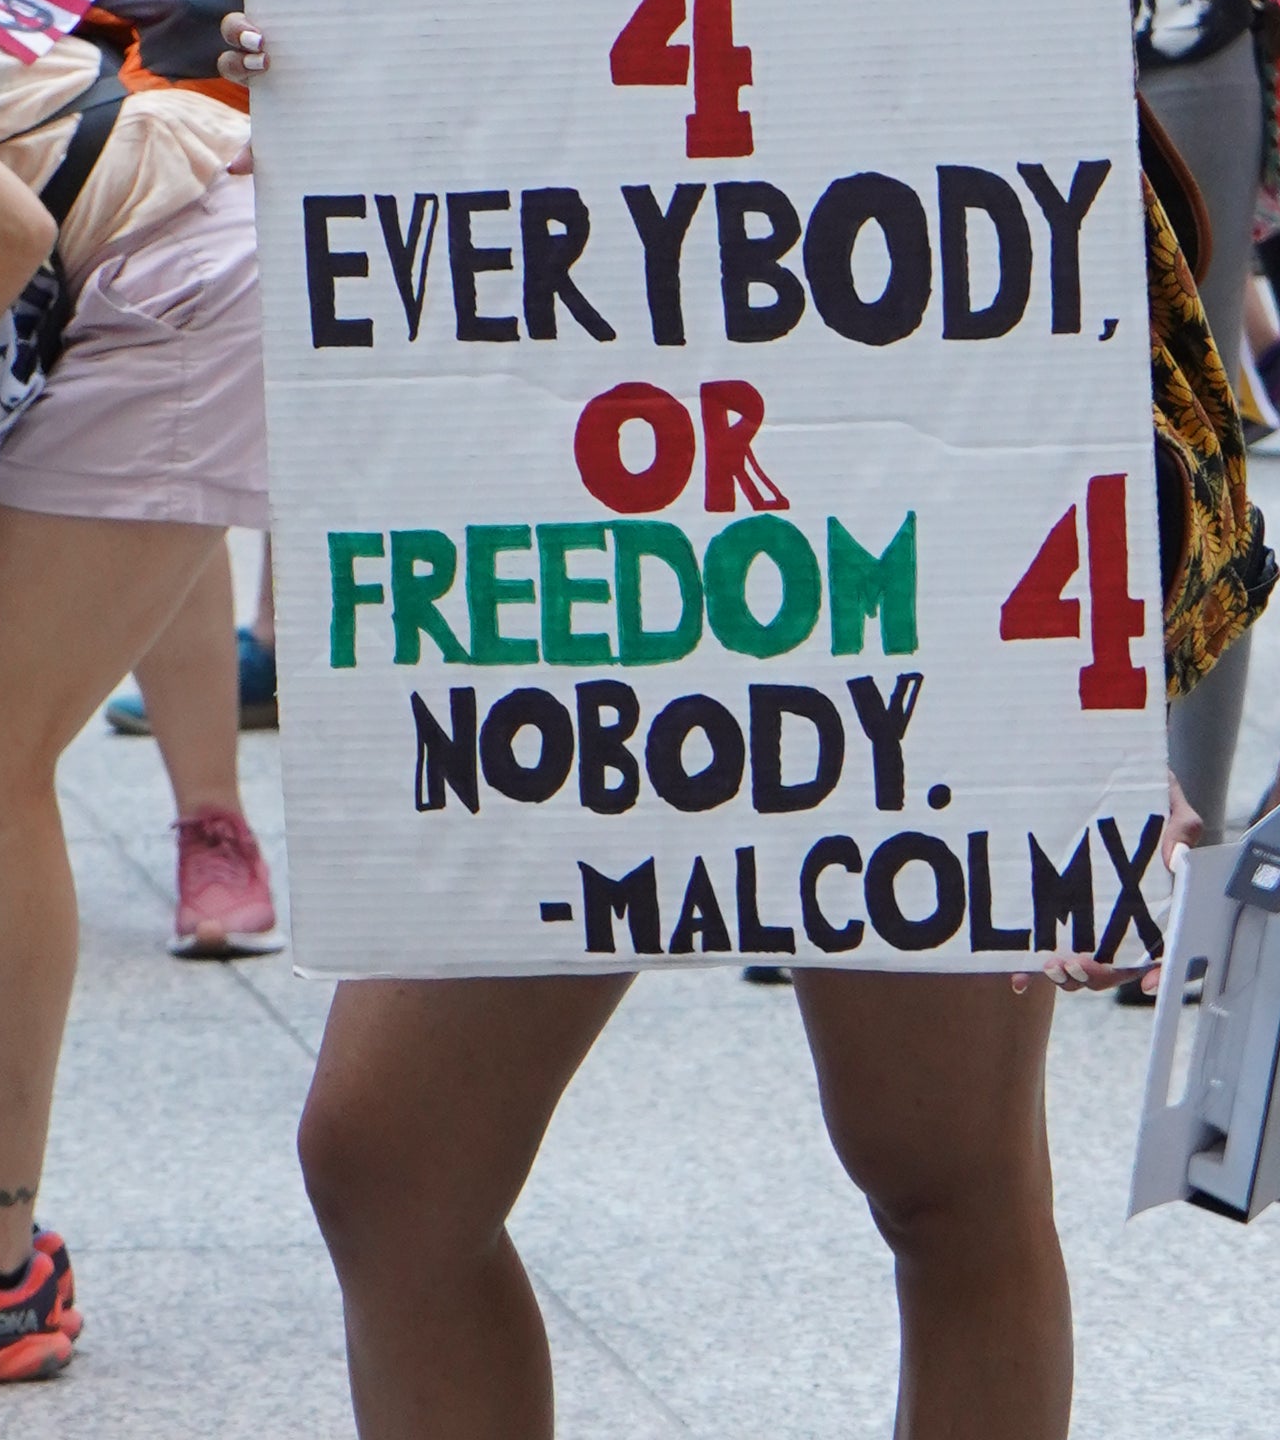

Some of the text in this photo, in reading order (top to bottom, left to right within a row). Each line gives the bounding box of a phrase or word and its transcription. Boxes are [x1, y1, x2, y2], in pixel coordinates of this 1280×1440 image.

[302, 158, 1121, 350] EVERYBODY,
[573, 379, 790, 514] OR
[326, 472, 1148, 711] FREEDOM 4
[411, 671, 954, 816] NOBODY.
